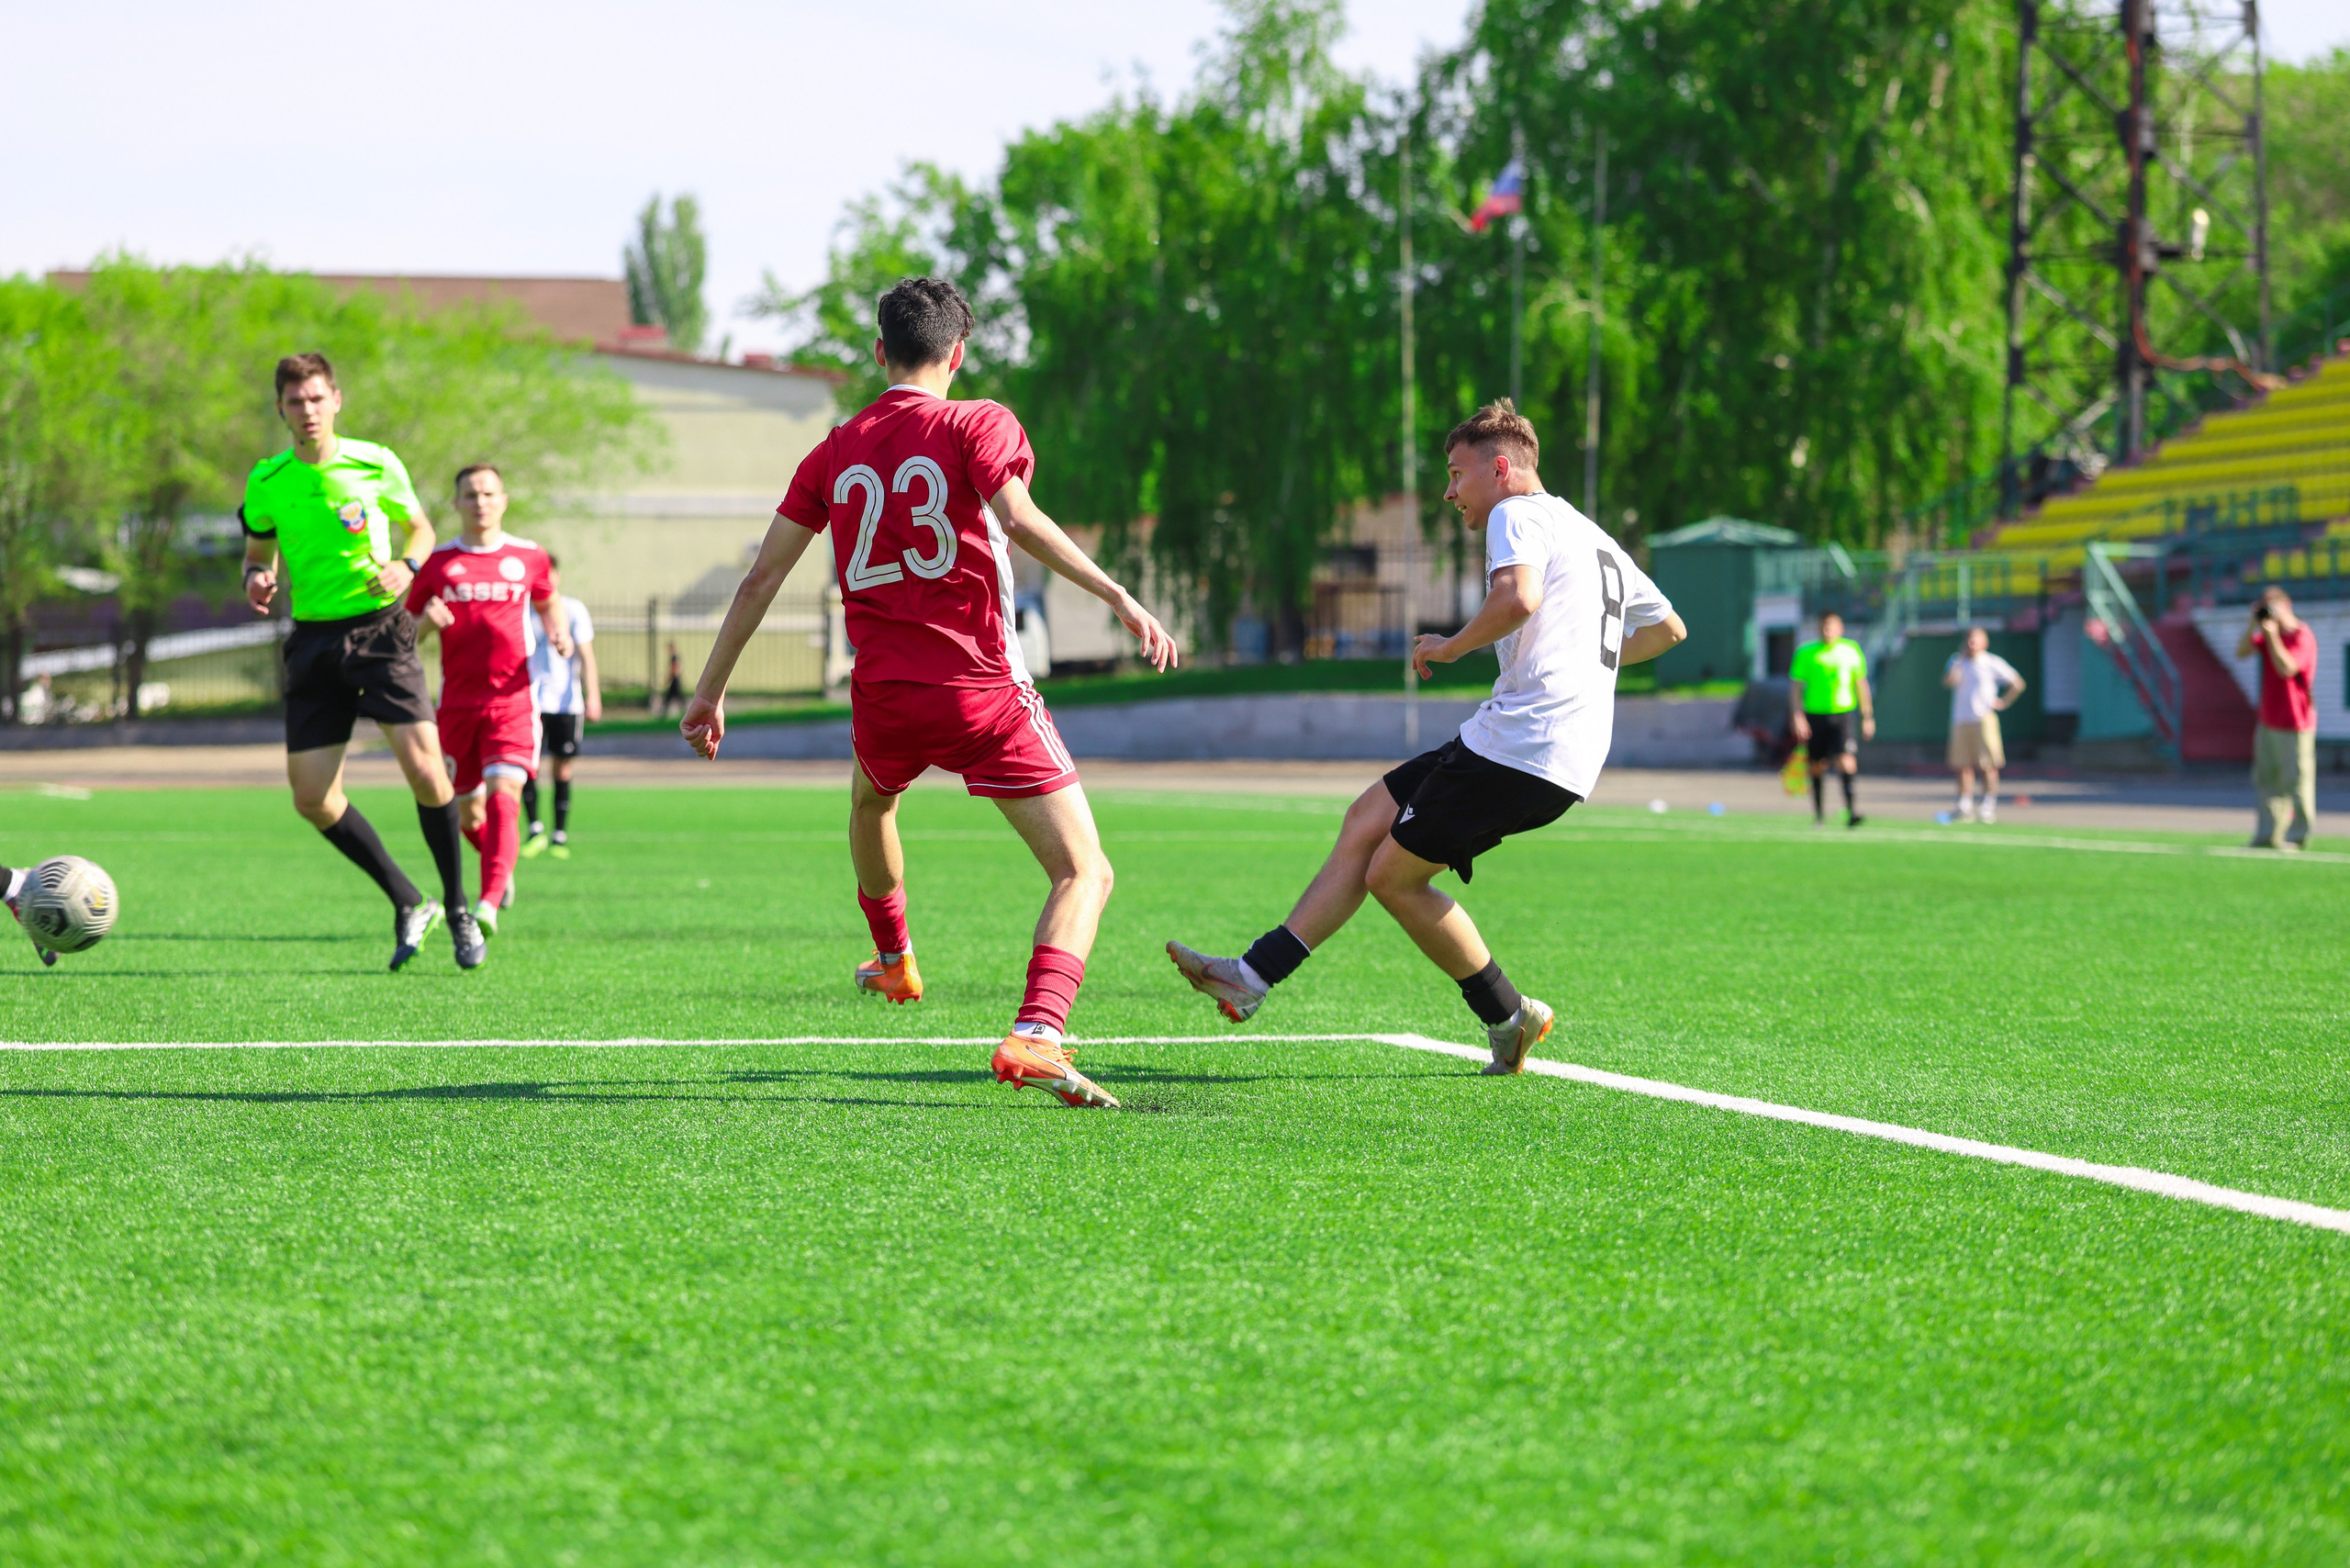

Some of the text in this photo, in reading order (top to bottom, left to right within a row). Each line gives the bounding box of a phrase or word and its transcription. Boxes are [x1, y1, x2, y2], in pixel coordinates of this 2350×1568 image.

[834, 455, 957, 592] 23
[442, 582, 526, 602] ASSET
[1596, 548, 1624, 671] 8
